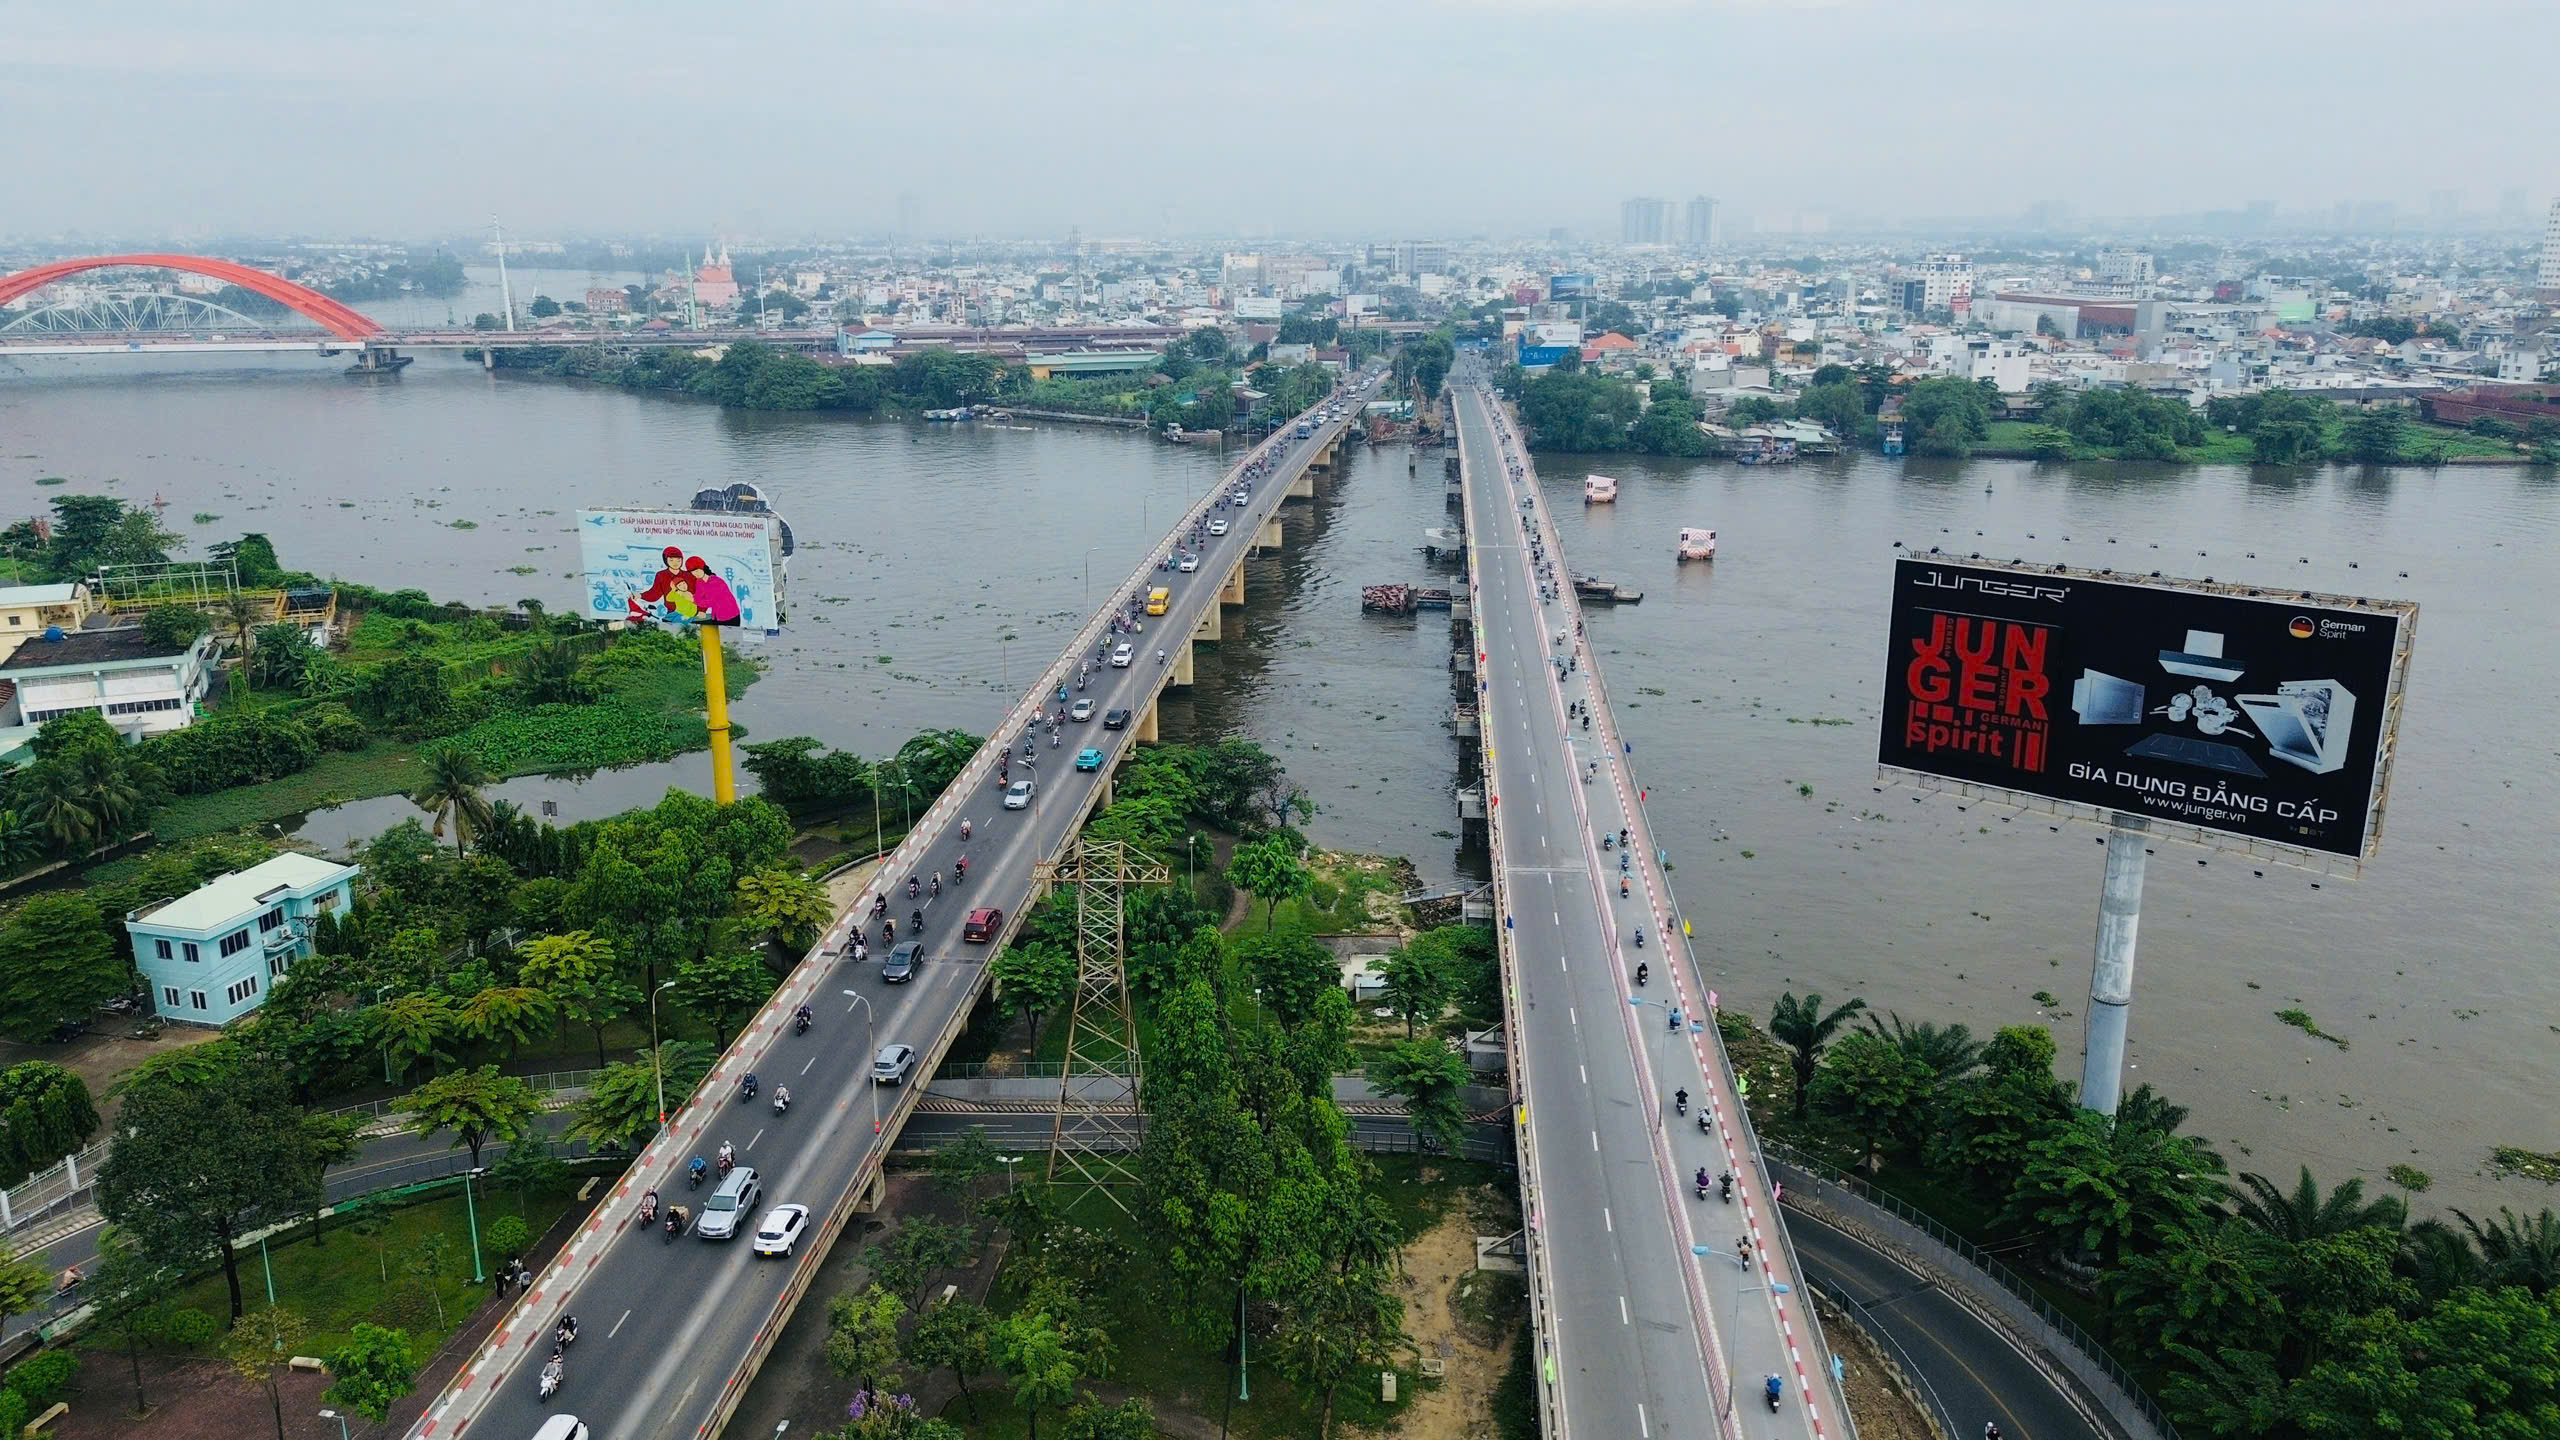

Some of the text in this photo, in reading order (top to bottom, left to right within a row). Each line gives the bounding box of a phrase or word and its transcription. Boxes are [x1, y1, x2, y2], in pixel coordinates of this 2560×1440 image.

[2319, 627, 2347, 640] Spirit
[2320, 619, 2366, 633] German
[1980, 712, 2042, 731] GERMAN
[1910, 719, 2003, 757] spirit
[2143, 795, 2247, 823] www.junger.vn
[2277, 798, 2338, 823] CẤP
